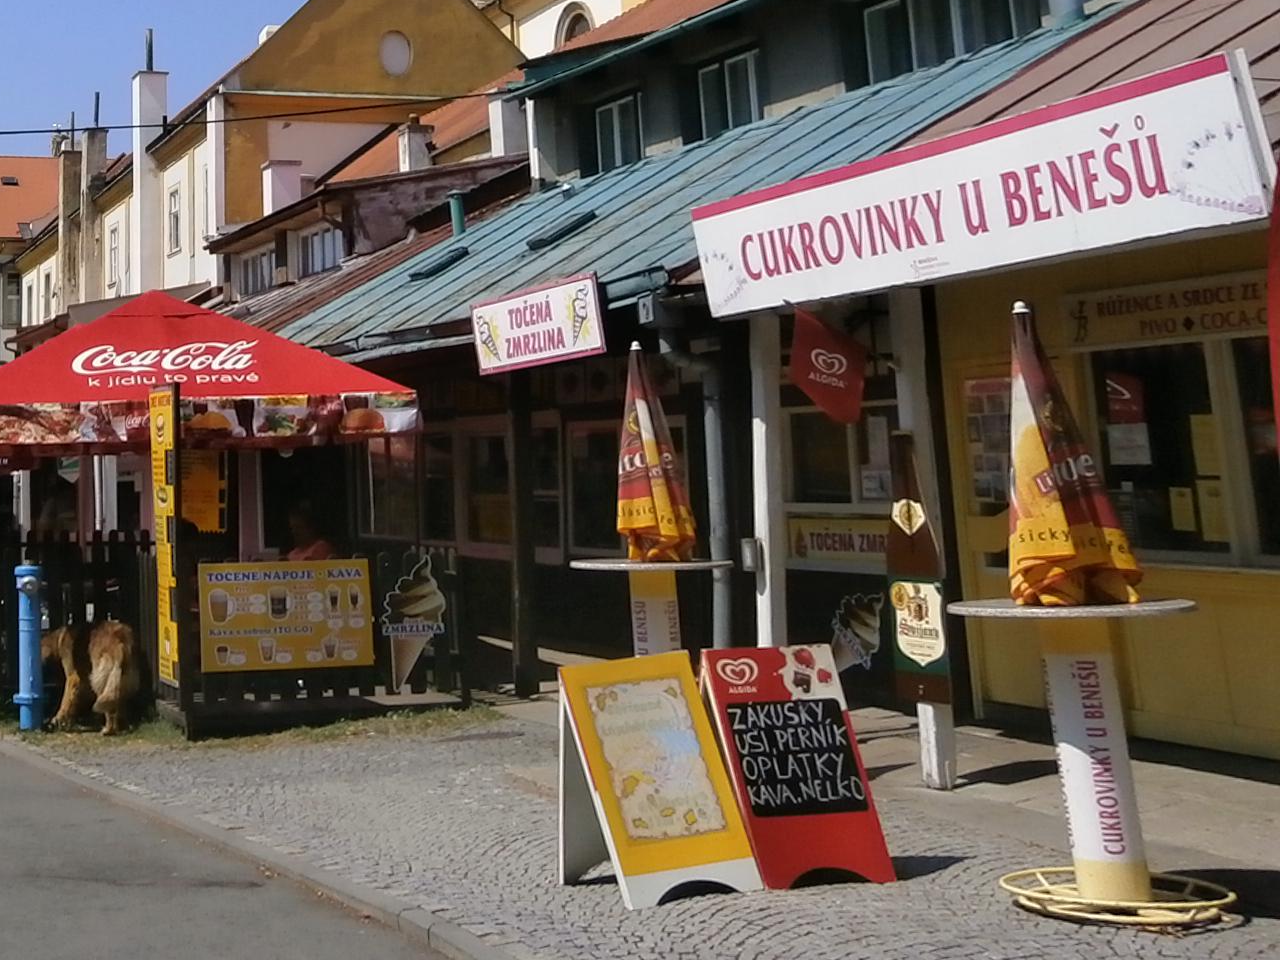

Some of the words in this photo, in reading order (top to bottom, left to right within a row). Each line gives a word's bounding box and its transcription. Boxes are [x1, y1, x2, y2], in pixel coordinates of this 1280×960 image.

[741, 189, 946, 282] CUKROVINKY
[958, 179, 990, 238] U
[999, 114, 1170, 229] BENEŠŮ
[1167, 292, 1179, 309] A
[1183, 285, 1235, 308] SRDCE
[1241, 282, 1262, 301] ZE
[508, 294, 553, 331] TOČENÁ
[1139, 317, 1177, 337] PIVO
[505, 326, 567, 360] ZMRZLINA
[71, 339, 259, 375] Coca-Cola
[88, 376, 101, 387] k
[107, 373, 157, 388] jídlu
[164, 372, 188, 384] to
[195, 372, 260, 385] pravé
[808, 371, 845, 389] ALGIDA
[809, 526, 855, 552] TOČENÁ
[385, 623, 442, 633] ZMRZLINA
[728, 685, 758, 695] ALGIDA
[773, 718, 847, 753] PERNÍK
[1087, 727, 1108, 738] U
[742, 753, 845, 789] OPLATKY
[1090, 744, 1126, 856] CUKROVINKY
